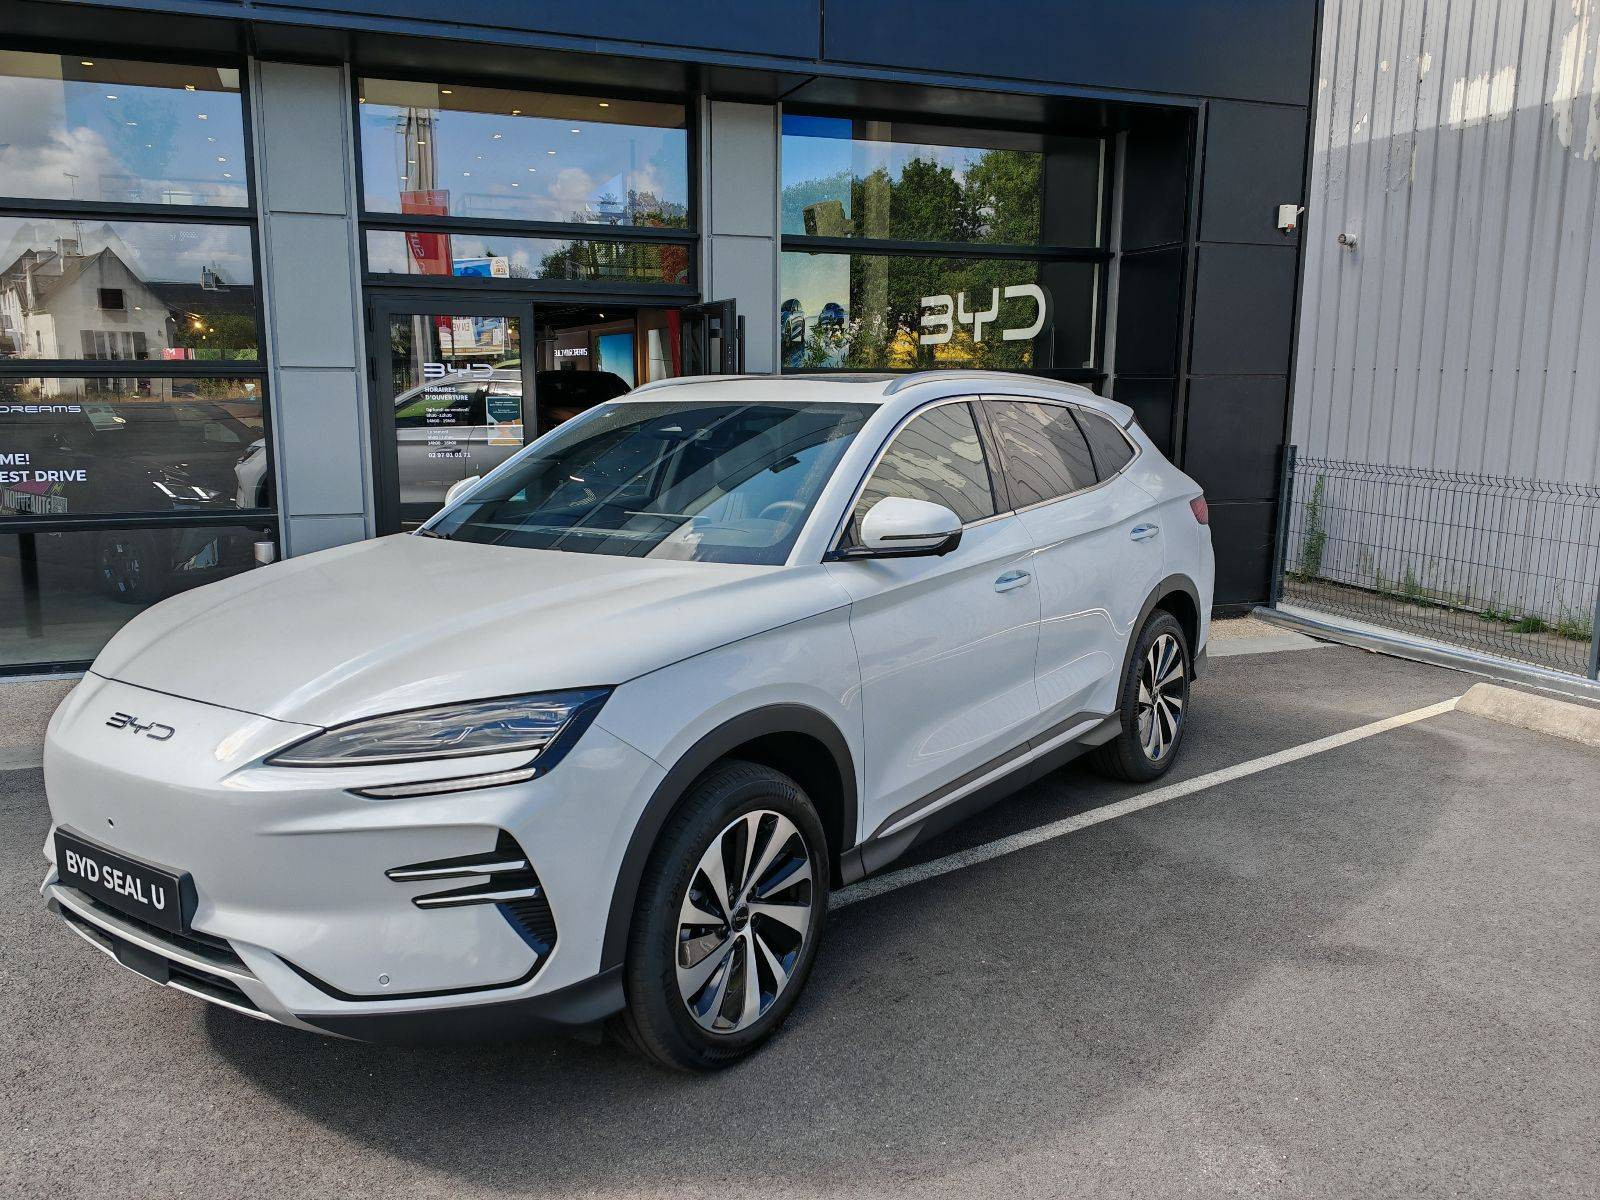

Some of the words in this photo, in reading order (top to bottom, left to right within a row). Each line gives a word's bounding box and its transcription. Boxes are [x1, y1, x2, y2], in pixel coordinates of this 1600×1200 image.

[920, 284, 1046, 344] BYD
[424, 362, 493, 378] BYD
[35, 470, 87, 482] DRIVE
[105, 712, 175, 742] BYD
[66, 850, 99, 882] BYD
[102, 865, 148, 904] SEAL
[151, 884, 165, 910] U
